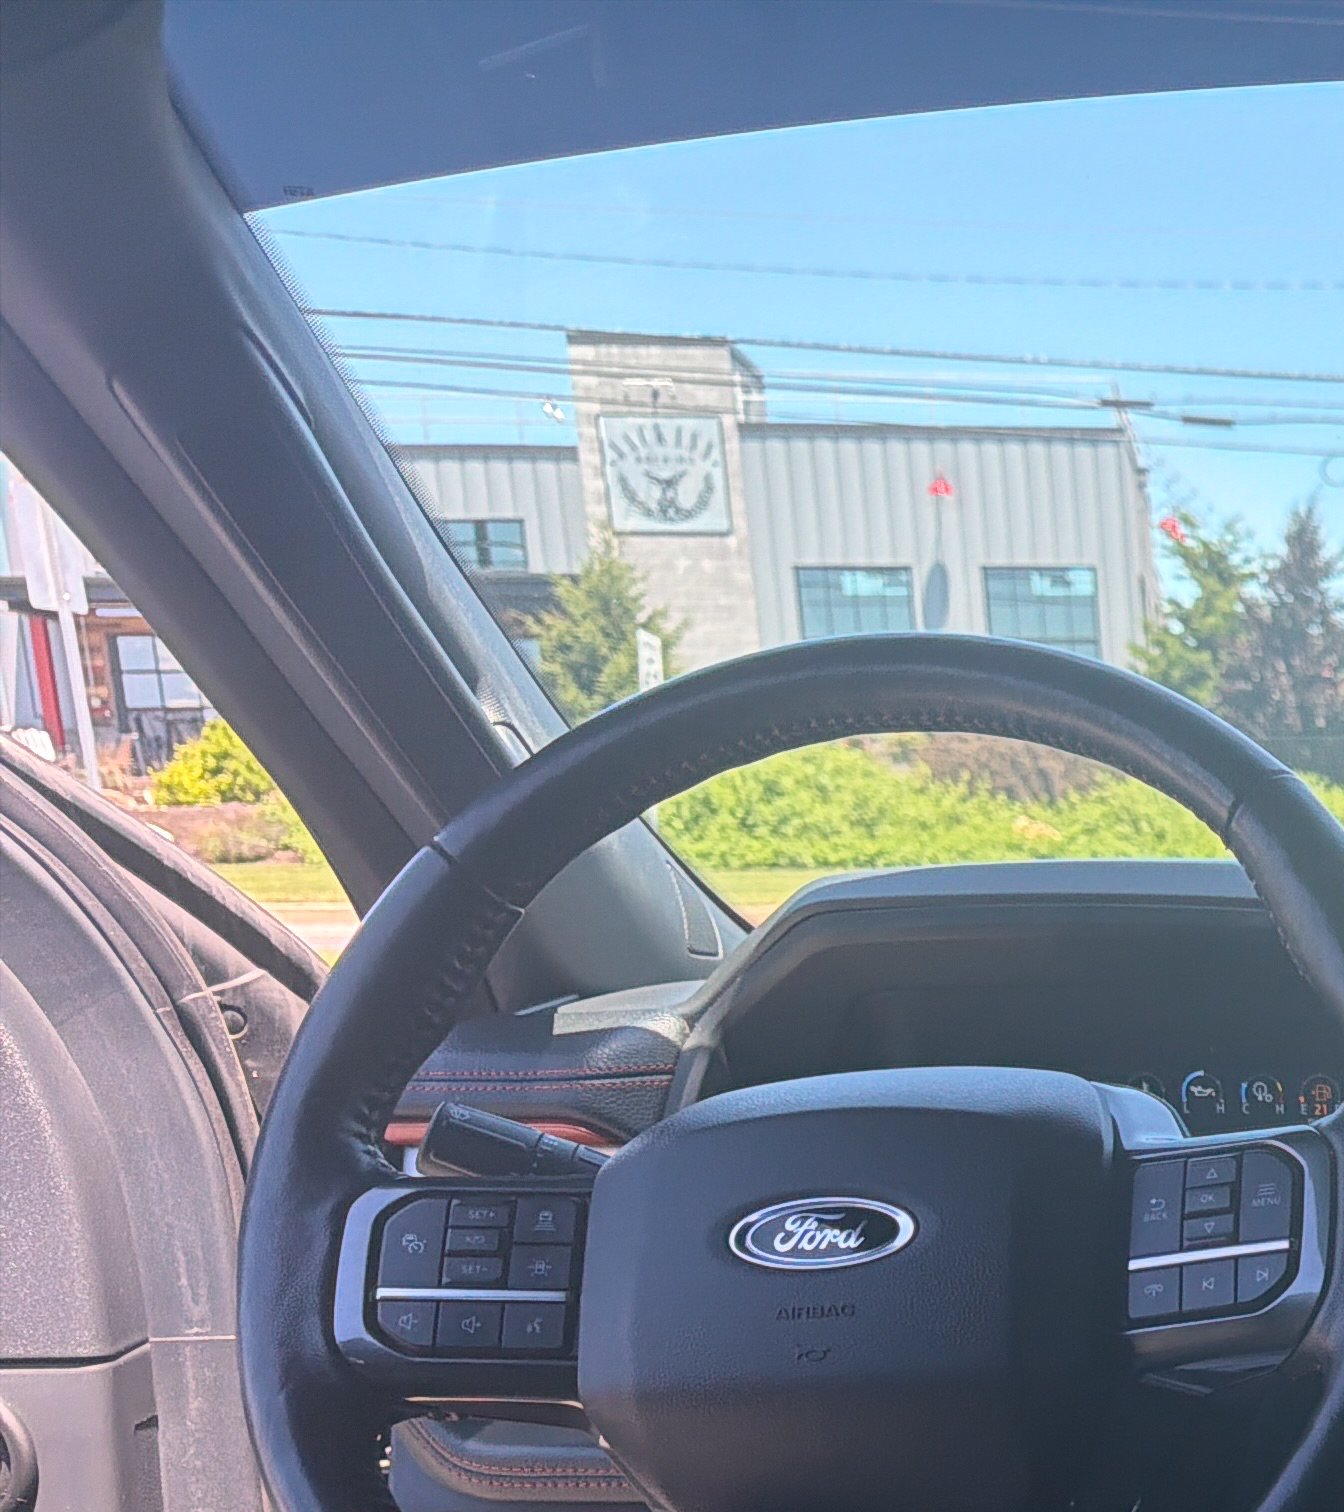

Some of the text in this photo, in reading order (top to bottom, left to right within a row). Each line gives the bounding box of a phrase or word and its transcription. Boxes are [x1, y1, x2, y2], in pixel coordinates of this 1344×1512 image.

[1183, 1103, 1225, 1114] L H
[1242, 1103, 1284, 1114] C H
[1301, 1103, 1328, 1115] E 21
[1200, 1193, 1215, 1203] OK
[1252, 1197, 1281, 1208] MENU
[1143, 1212, 1168, 1223] BACK
[773, 1212, 867, 1252] Ford
[776, 1303, 856, 1321] AIRBAG
